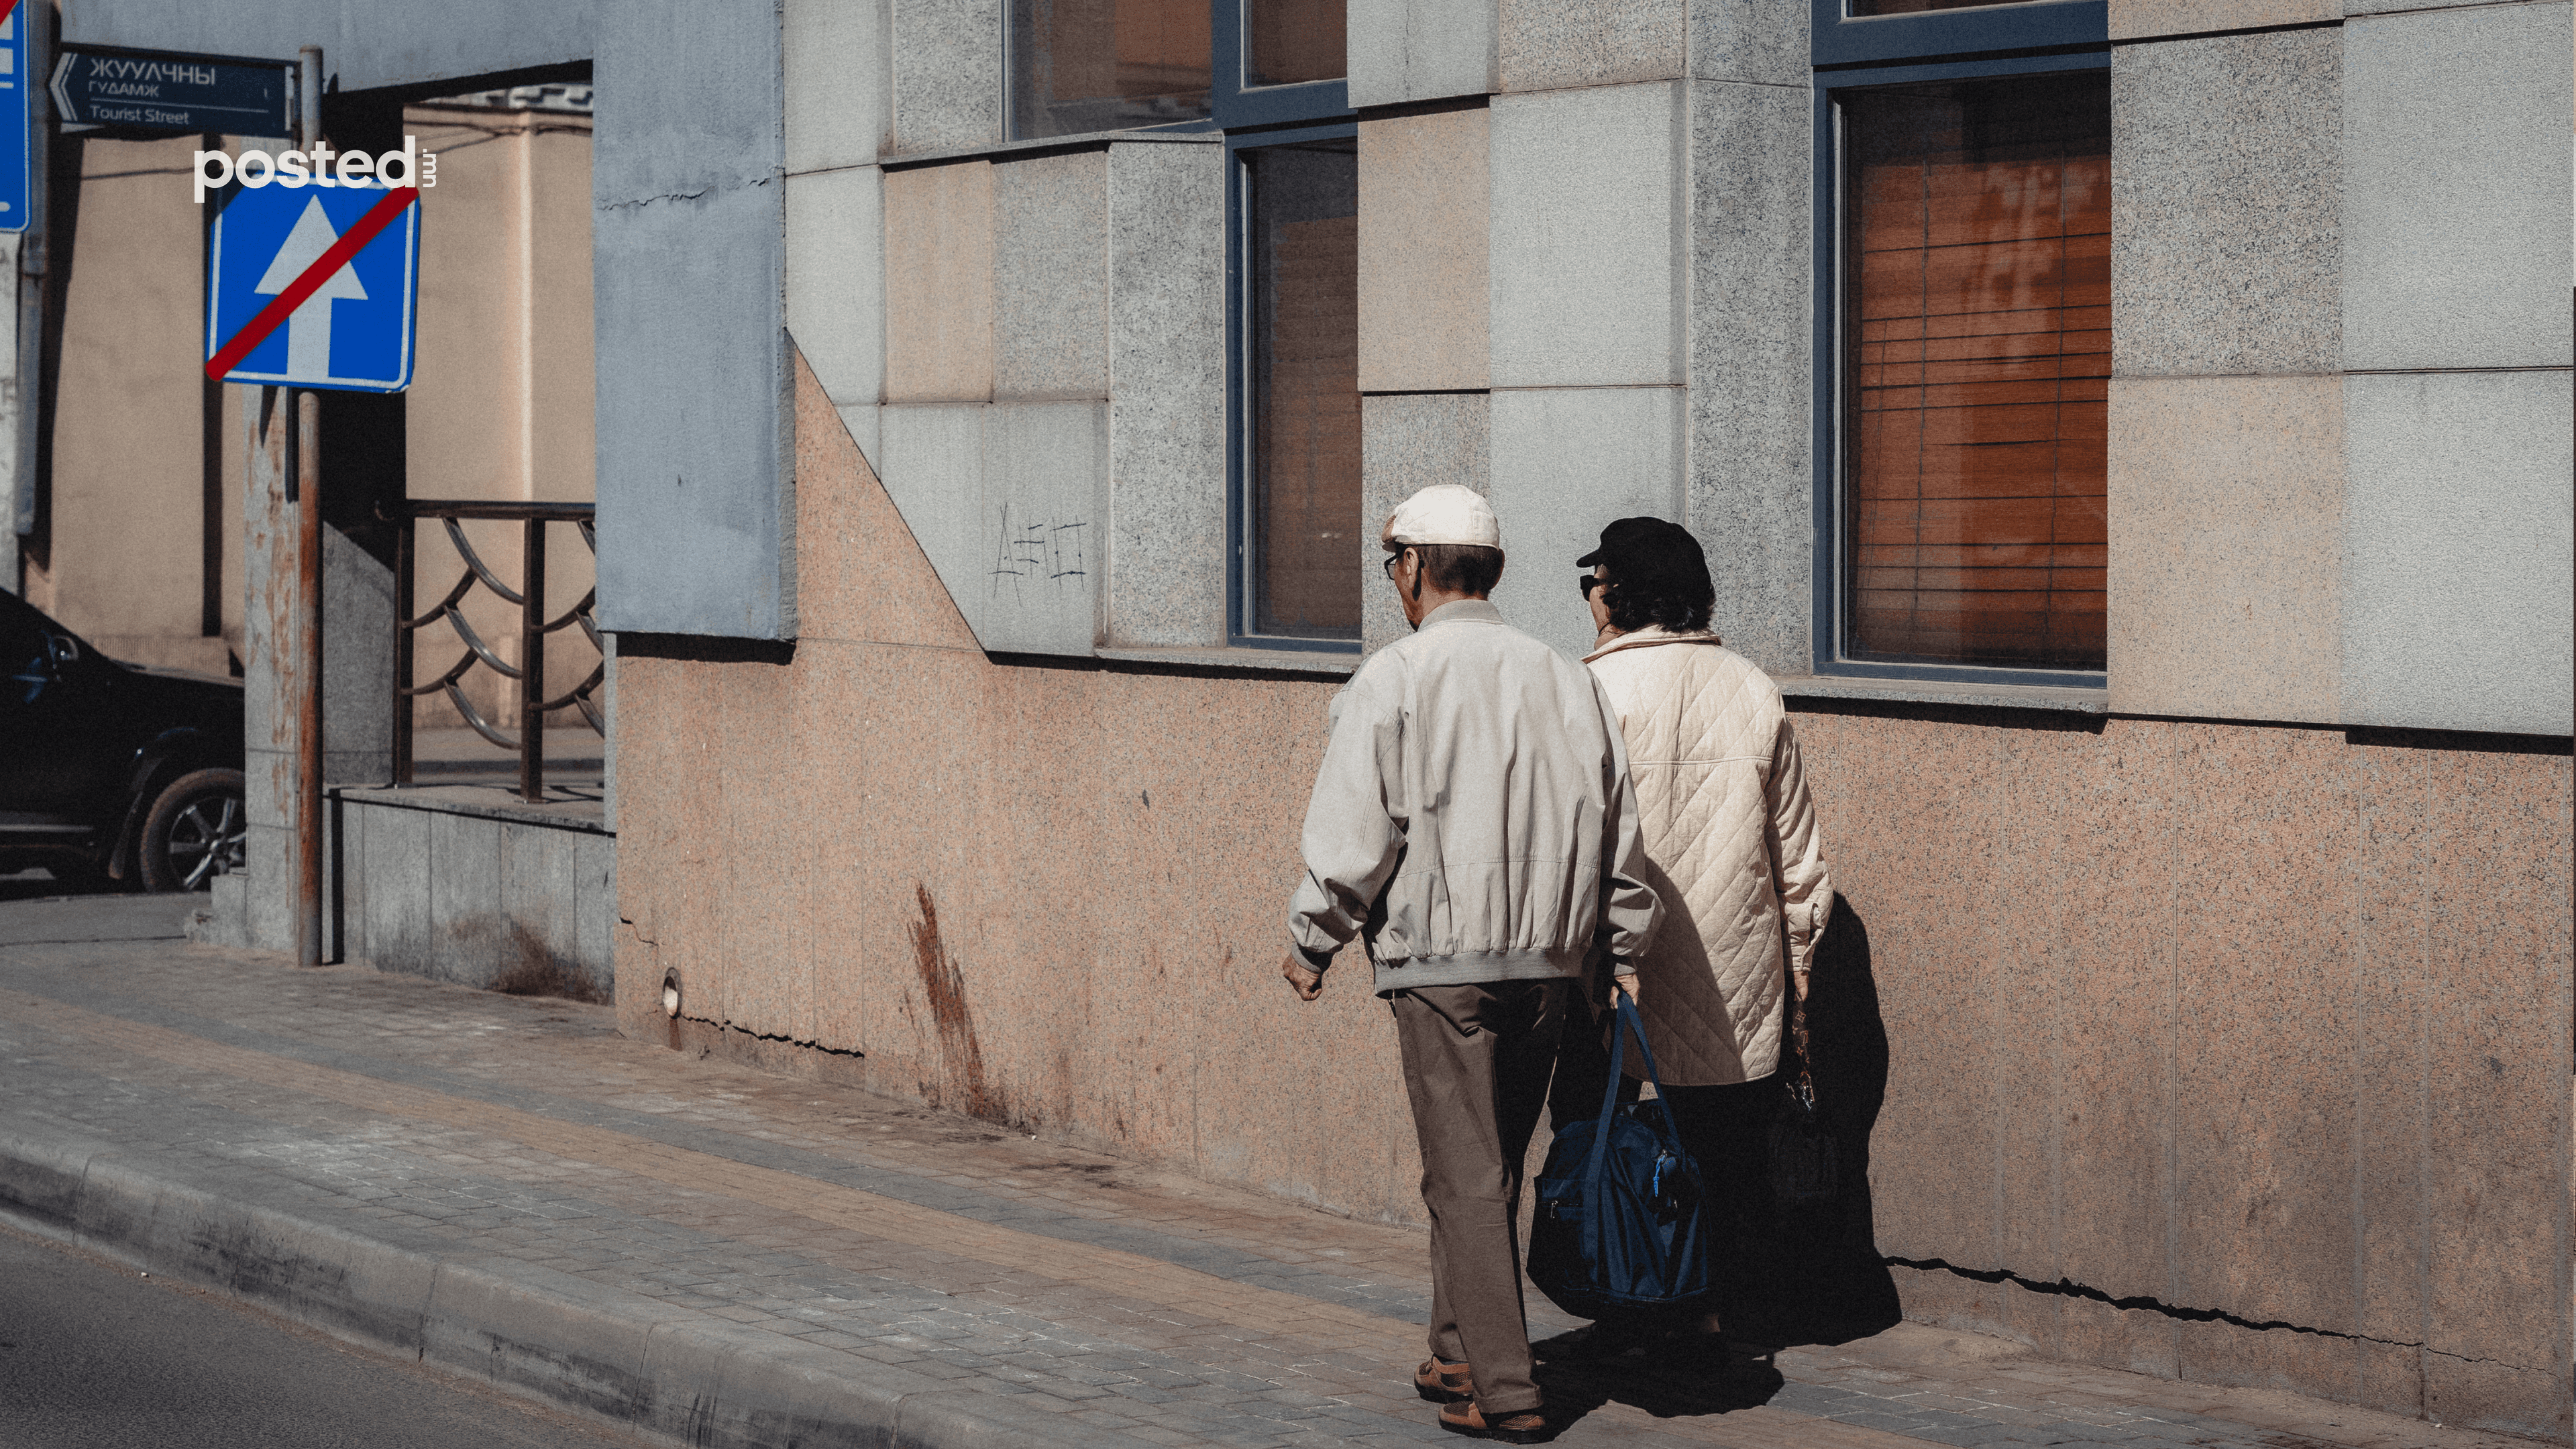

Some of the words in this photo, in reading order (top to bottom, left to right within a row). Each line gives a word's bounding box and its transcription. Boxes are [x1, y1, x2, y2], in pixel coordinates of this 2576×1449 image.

[90, 58, 215, 85] ЖУУЛЧНЫ
[89, 80, 160, 97] ГУДАМЖ
[89, 104, 141, 121] Tourist
[145, 109, 189, 125] Street
